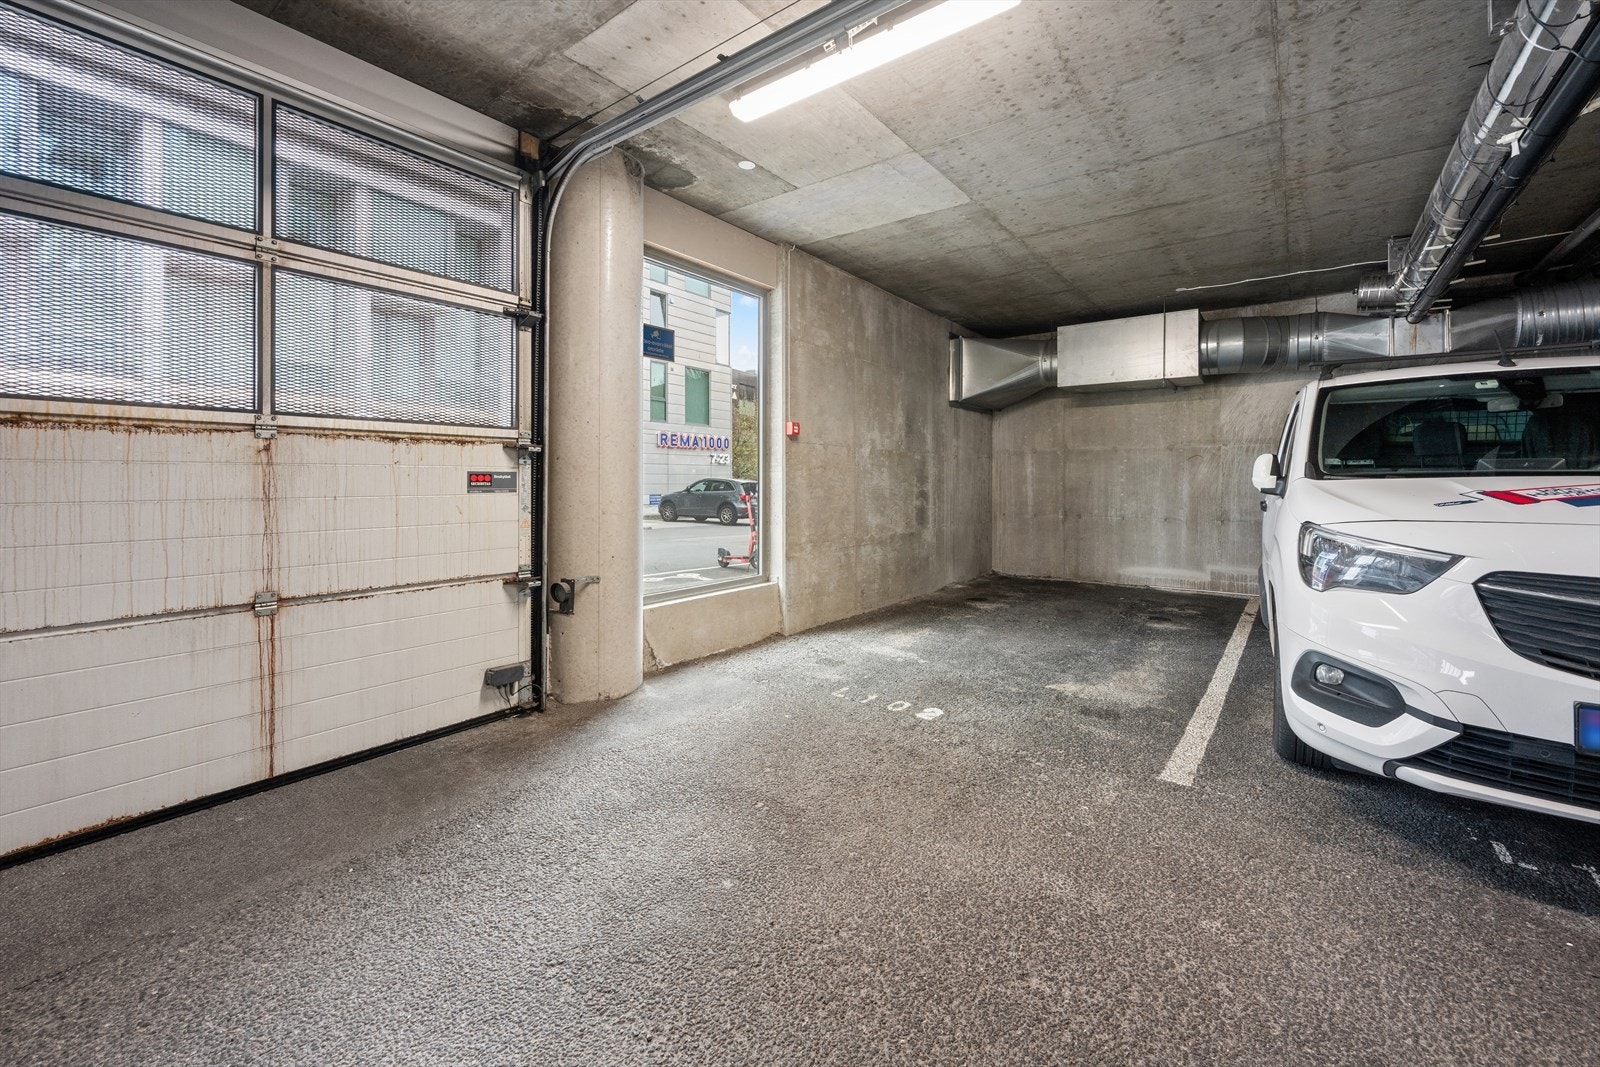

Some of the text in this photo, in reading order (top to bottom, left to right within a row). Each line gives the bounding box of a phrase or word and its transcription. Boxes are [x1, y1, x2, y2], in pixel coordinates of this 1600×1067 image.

[658, 432, 730, 449] REMA 1000
[711, 453, 730, 464] 7-23
